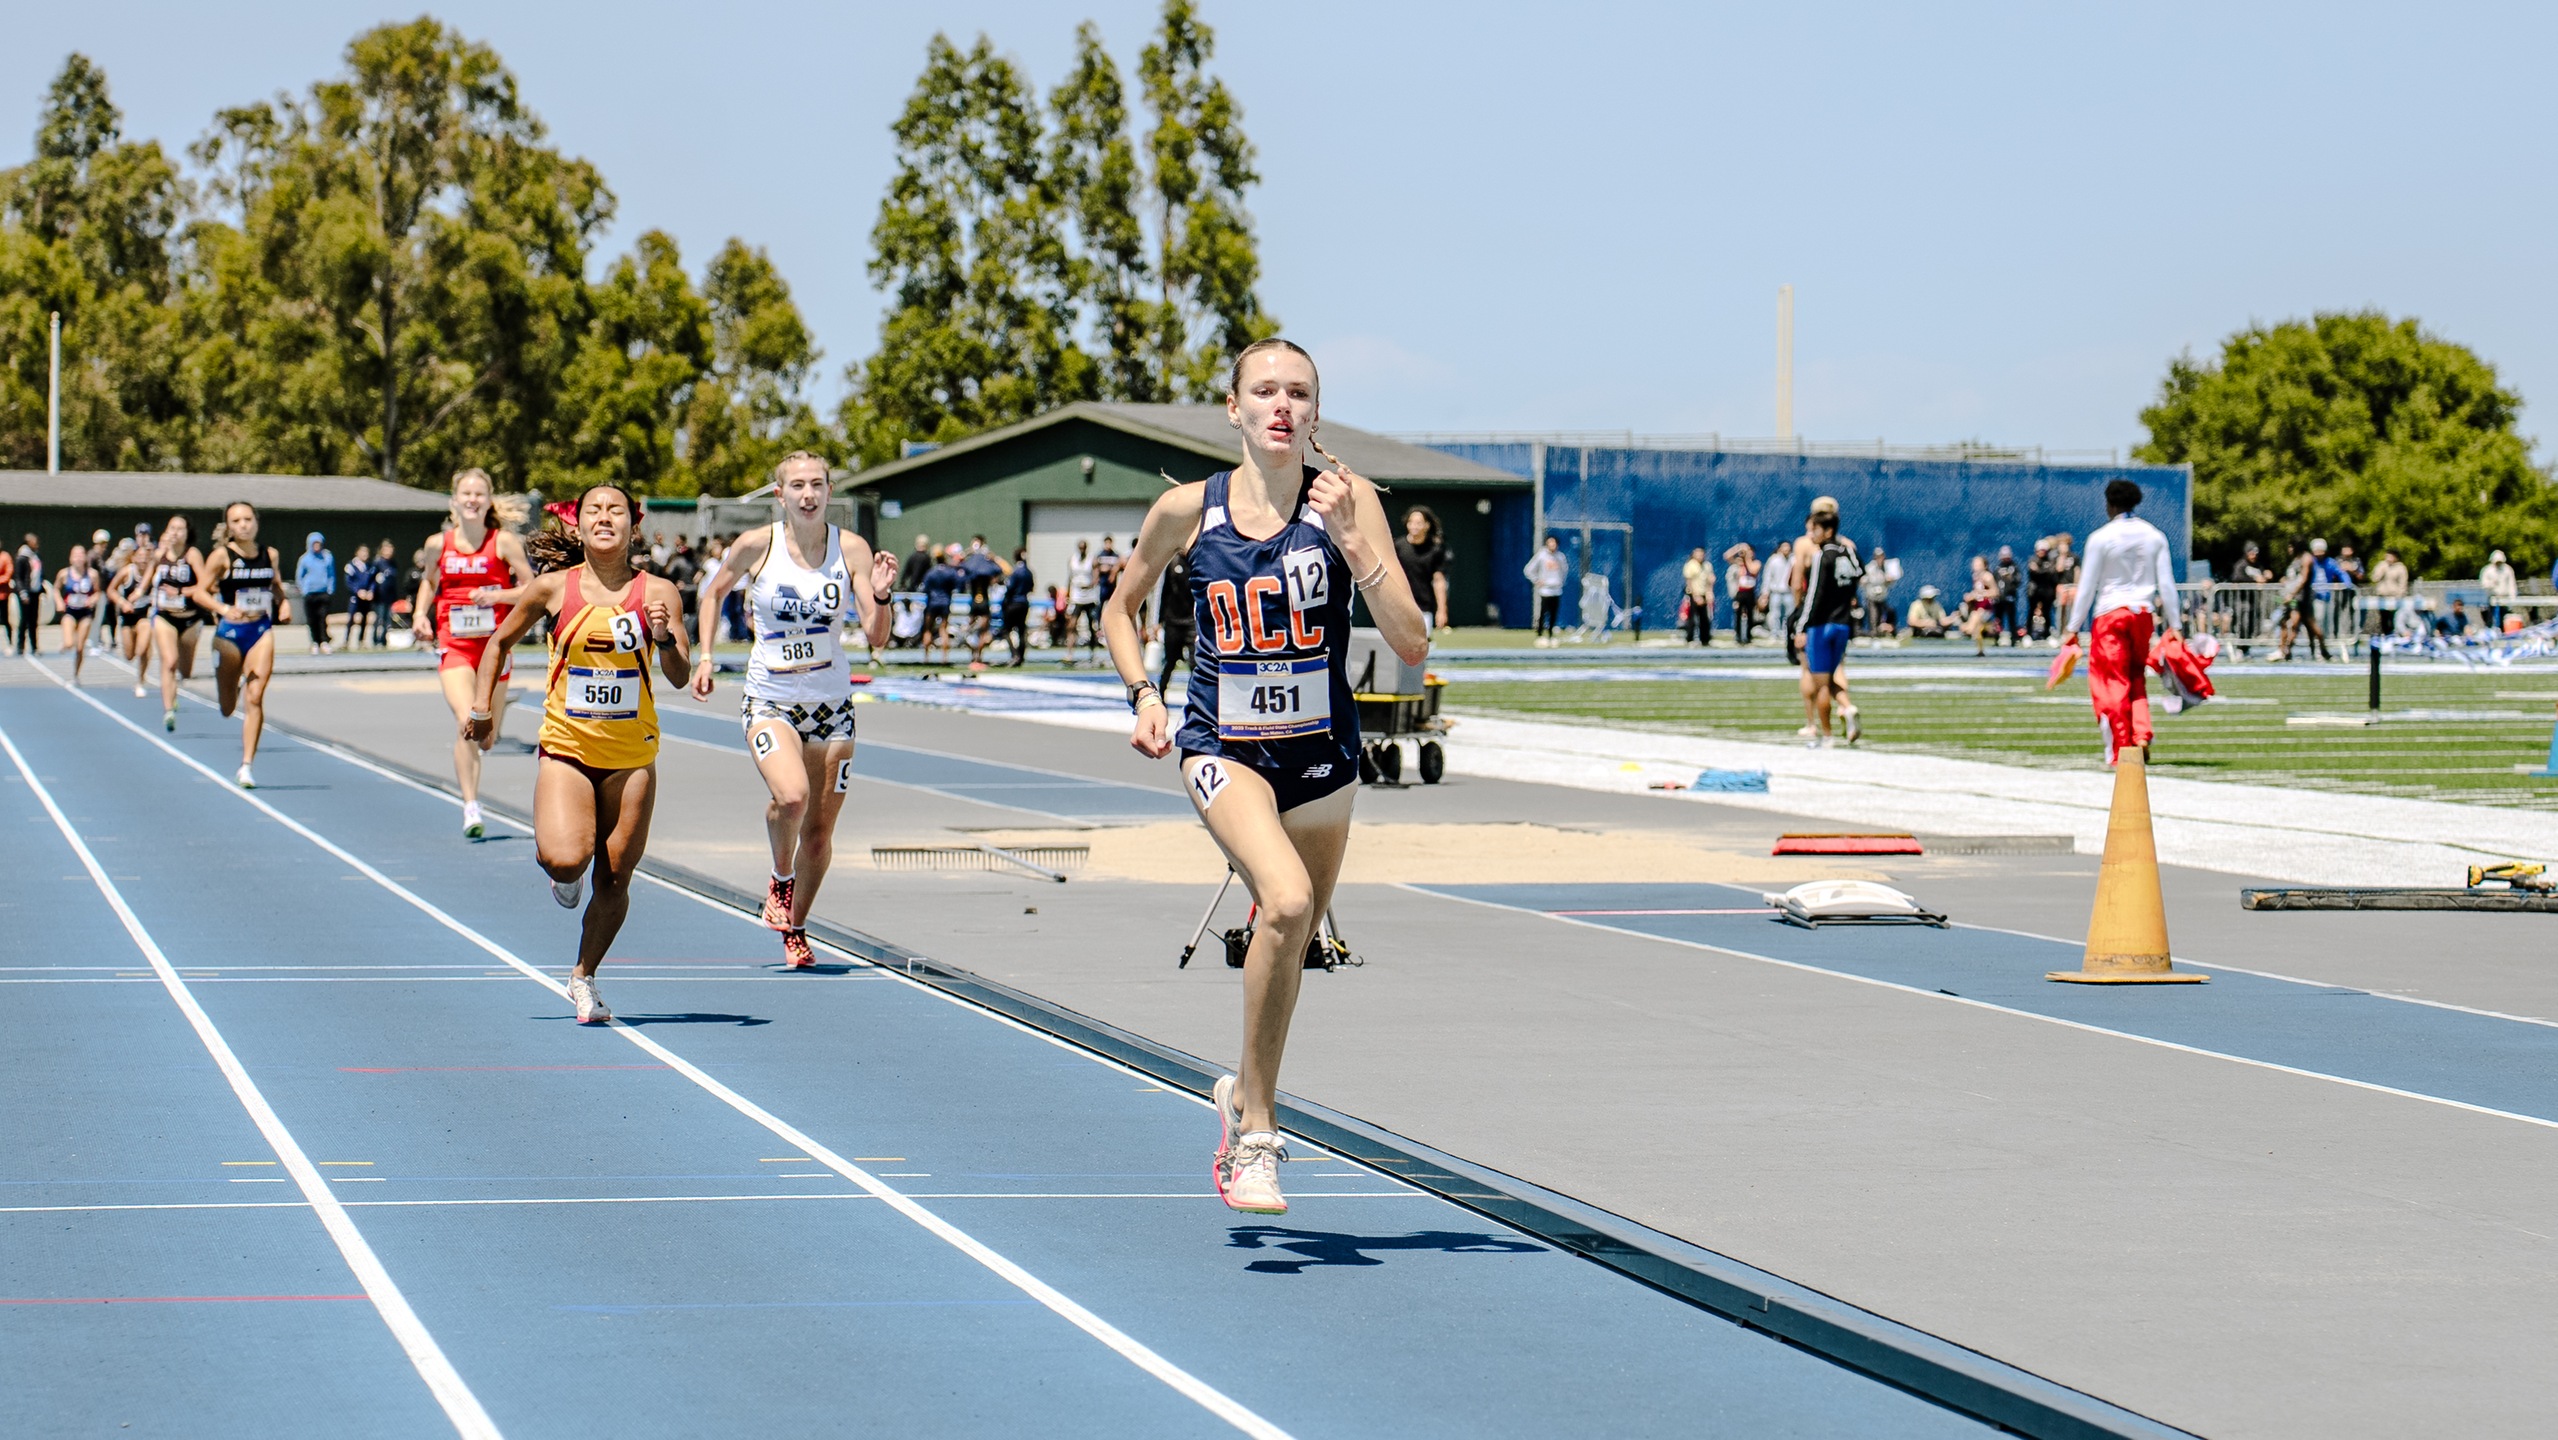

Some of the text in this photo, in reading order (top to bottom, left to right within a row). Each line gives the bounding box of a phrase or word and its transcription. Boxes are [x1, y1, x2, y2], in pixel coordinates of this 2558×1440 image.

[1288, 560, 1326, 602] 12
[783, 599, 820, 614] MES
[823, 582, 841, 610] 9
[616, 617, 638, 651] 3
[782, 641, 815, 661] 583
[1259, 662, 1290, 672] 3C2A
[585, 684, 622, 705] 550
[1250, 684, 1300, 714] 451
[755, 731, 774, 755] 9
[1194, 762, 1225, 802] 12
